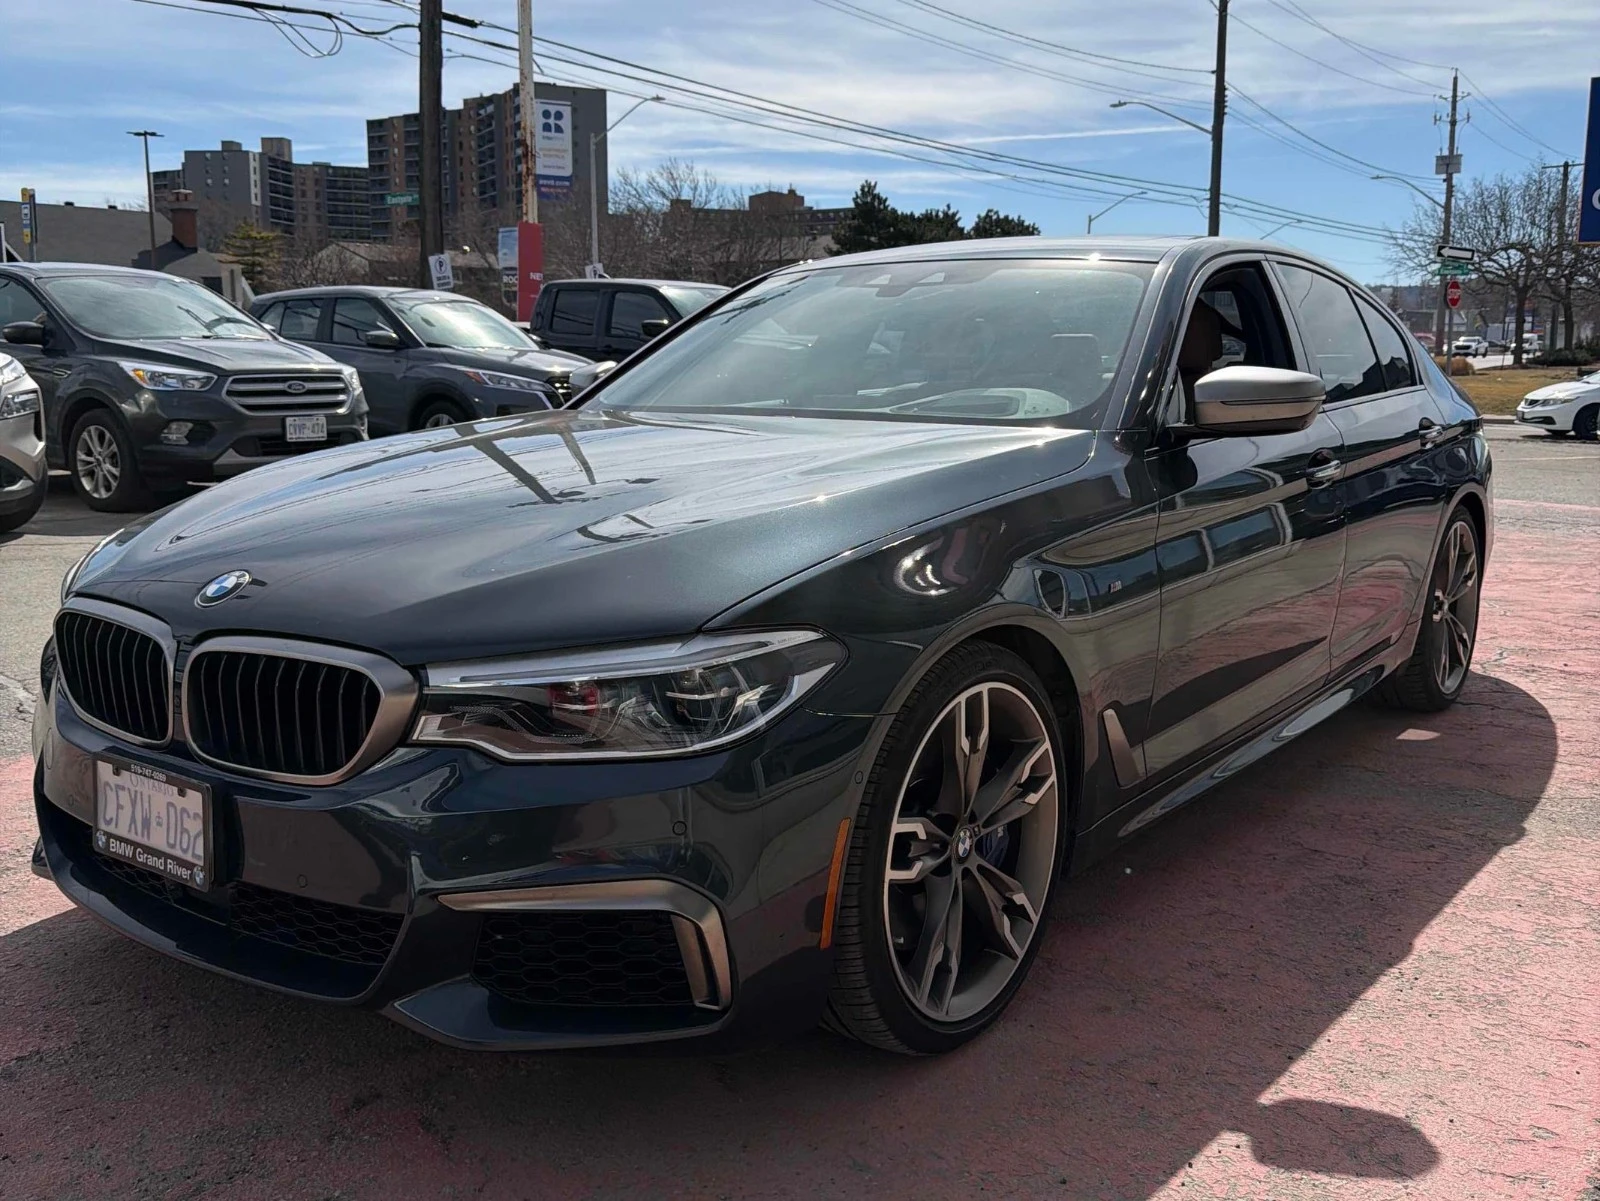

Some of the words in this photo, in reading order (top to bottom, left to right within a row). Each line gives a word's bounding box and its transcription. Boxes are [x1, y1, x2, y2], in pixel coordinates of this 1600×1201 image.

[103, 781, 152, 841] CFXW
[109, 838, 134, 858] BMW
[136, 848, 165, 870] Grand
[167, 859, 192, 880] River
